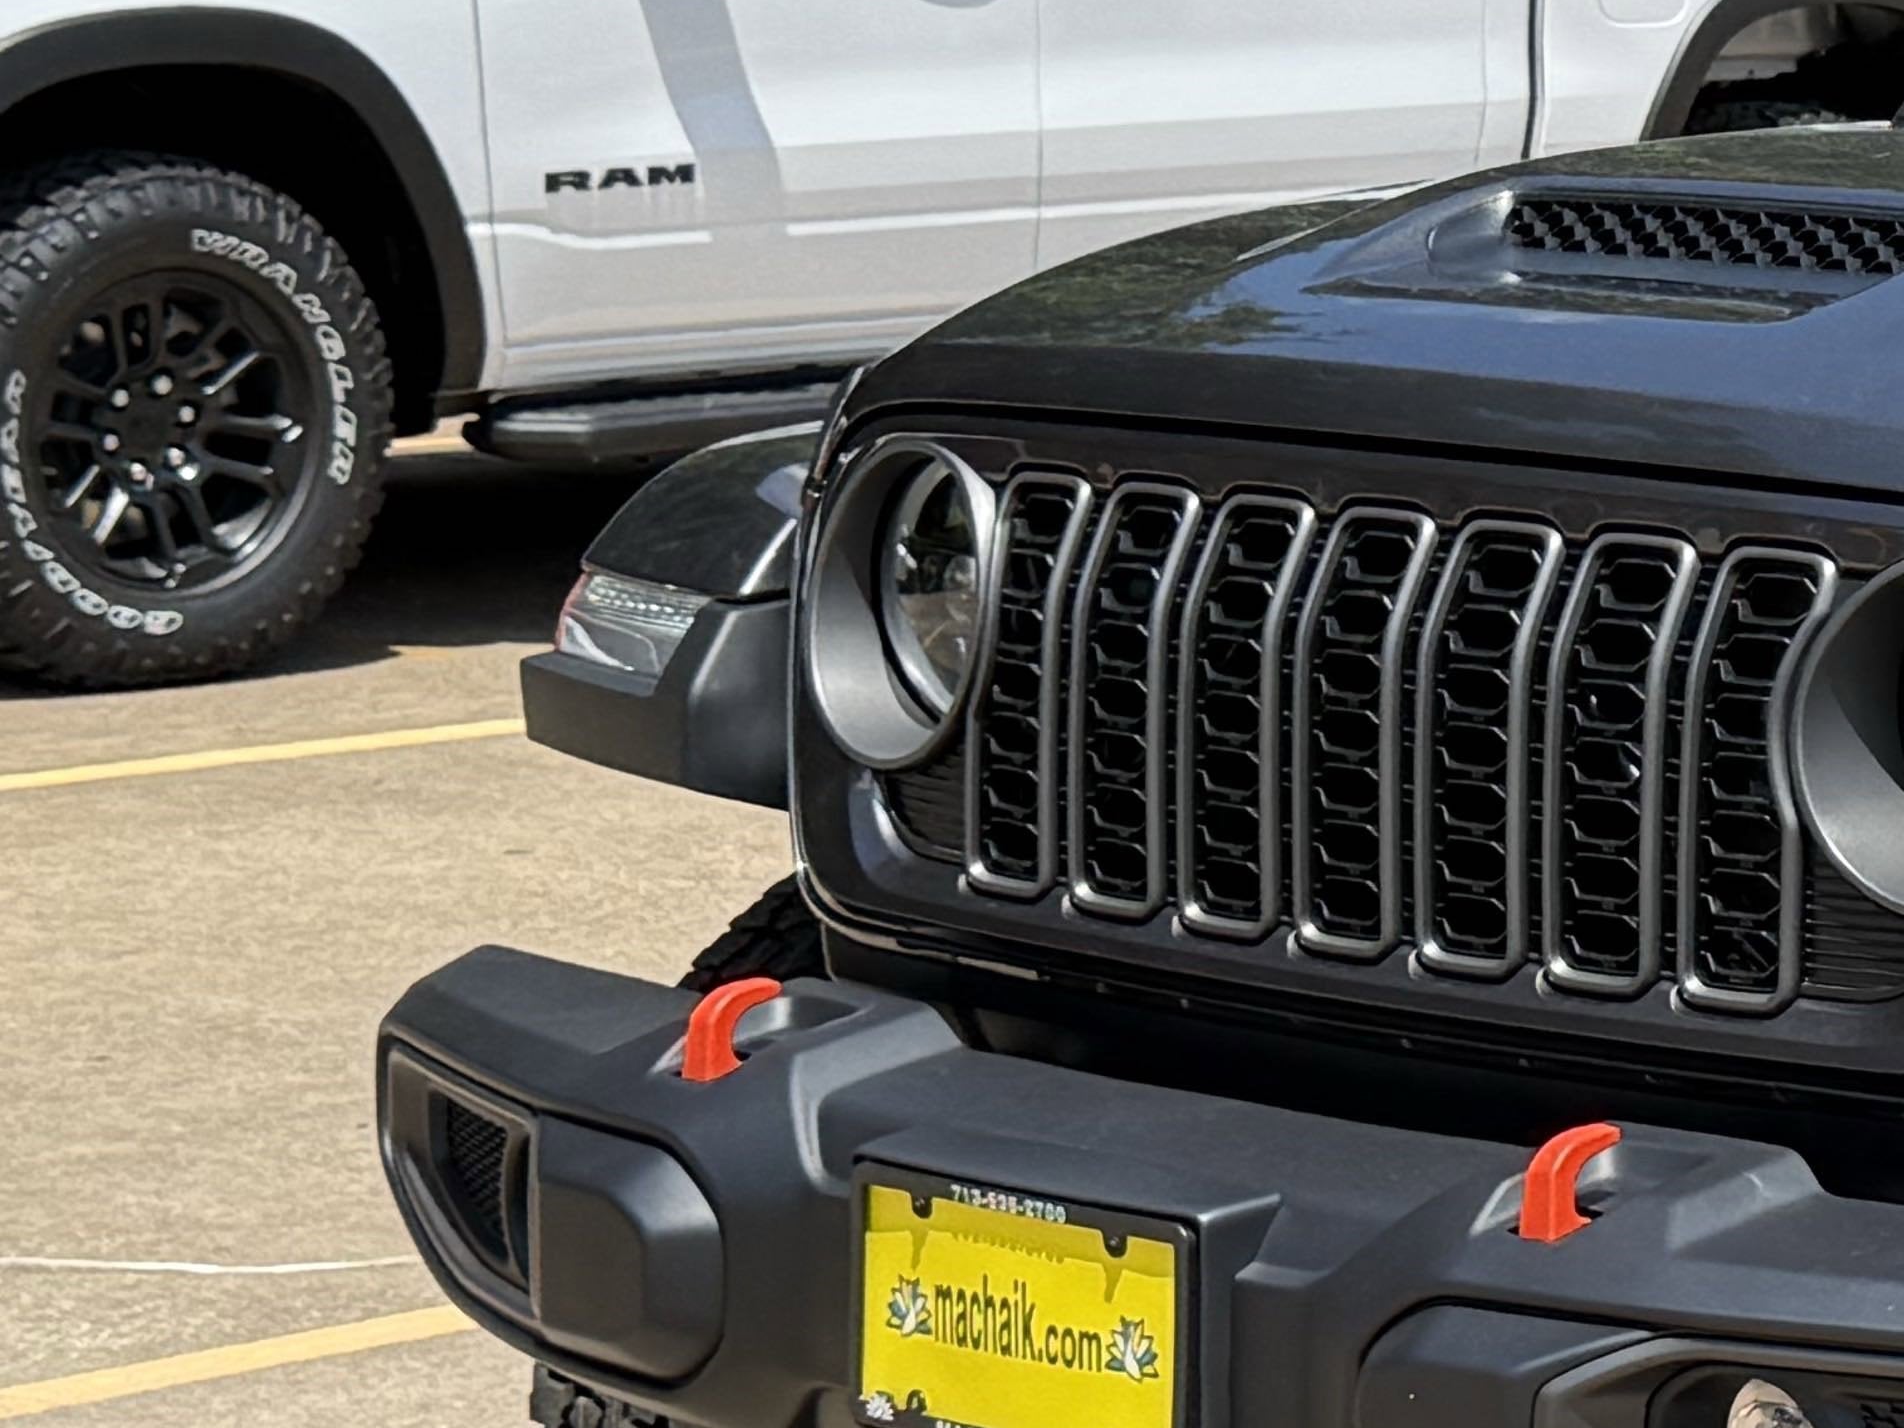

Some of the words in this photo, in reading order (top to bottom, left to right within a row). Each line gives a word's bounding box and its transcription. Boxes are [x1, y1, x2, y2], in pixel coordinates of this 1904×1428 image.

[545, 164, 695, 193] RAM
[191, 228, 359, 486] WRANGLER
[933, 1274, 1103, 1373] machaik.com
